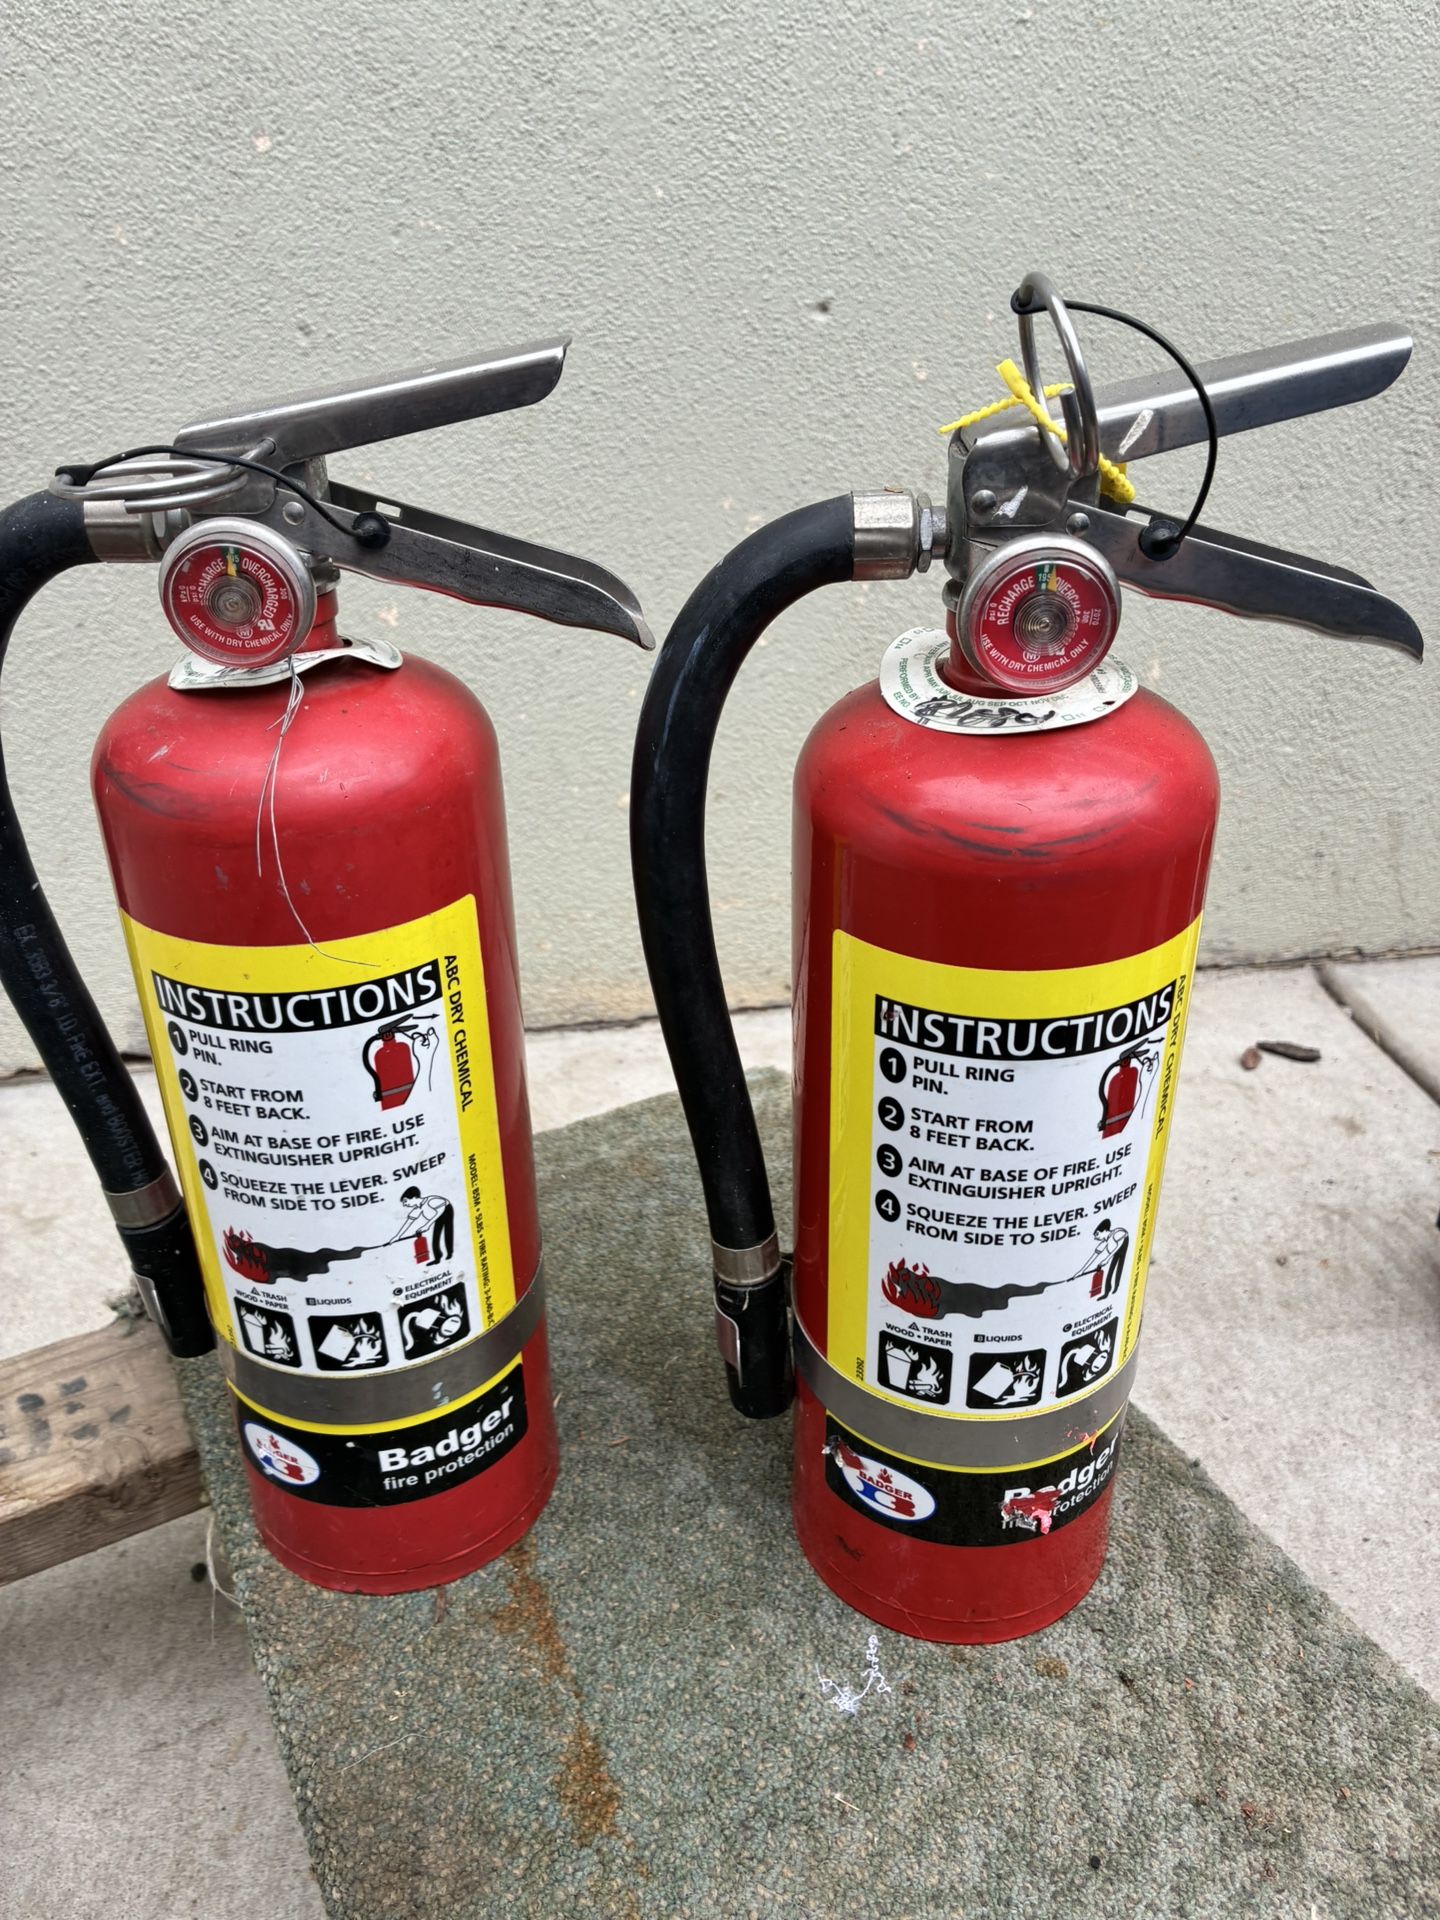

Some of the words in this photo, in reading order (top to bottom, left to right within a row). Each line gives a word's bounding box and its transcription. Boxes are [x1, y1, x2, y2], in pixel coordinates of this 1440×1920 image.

[241, 557, 280, 620] OVERCHARGED
[996, 575, 1036, 626] RECHARGE
[189, 614, 206, 631] USE
[204, 626, 225, 643] WITH
[226, 637, 244, 648] DRY
[244, 630, 283, 648] CHEMICAL
[280, 612, 295, 633] ONLY
[981, 633, 991, 651] USE
[989, 647, 1009, 666] WITH
[1007, 660, 1026, 672] DRY
[1027, 655, 1071, 673] CHEMICAL
[1070, 638, 1090, 658] ONLY
[899, 657, 915, 695] PERFORMED
[908, 692, 921, 702] BY
[926, 677, 940, 688] MAY
[1008, 700, 1029, 708] OCT
[443, 954, 462, 990] ABC
[155, 965, 437, 1030] INSTRUCTIONS
[1175, 973, 1187, 1010] ABC
[448, 992, 467, 1027] DRY
[879, 985, 1173, 1057] INSTRUCTIONS
[189, 1029, 227, 1050] PULL
[230, 1038, 273, 1054] RING
[1169, 1013, 1182, 1047] DRY
[193, 1047, 223, 1067] PIN.
[454, 1028, 476, 1112] CHEMICAL
[912, 1055, 960, 1078] PULL
[965, 1065, 1016, 1083] RING
[199, 1078, 245, 1099] START
[252, 1086, 304, 1104] FROM
[911, 1075, 949, 1096] PIN.
[1153, 1051, 1176, 1141] CHEMICAL
[203, 1095, 213, 1109] 8
[217, 1099, 253, 1118] FEET
[256, 1104, 311, 1121] BACK.
[910, 1106, 970, 1131] START
[975, 1118, 1034, 1134] FROM
[211, 1126, 239, 1145] AIM
[244, 1133, 261, 1148] AT
[268, 1135, 312, 1151] BASE
[318, 1134, 341, 1148] OF
[345, 1125, 388, 1145] FIRE.
[392, 1113, 426, 1135] USE
[909, 1124, 921, 1140] 8
[926, 1128, 970, 1150] FEET
[975, 1135, 1036, 1153] BACK.
[213, 1142, 334, 1167] EXTINGUISHER
[339, 1133, 420, 1164] UPRIGHT.
[908, 1156, 946, 1176] AIM
[950, 1165, 975, 1181] AT
[980, 1168, 1029, 1183] BASE
[1033, 1166, 1058, 1181] OF
[1062, 1158, 1101, 1179] FIRE.
[1105, 1142, 1133, 1167] USE
[220, 1170, 285, 1195] SQUEEZE
[290, 1180, 324, 1196] THE
[329, 1169, 388, 1194] LEVER.
[393, 1151, 448, 1183] SWEEP
[466, 1153, 480, 1189] MODEL:
[907, 1172, 1046, 1200] EXTINGUISHER
[1051, 1164, 1124, 1198] UPRIGHT.
[223, 1186, 267, 1210] FROM
[270, 1194, 308, 1212] SIDE
[313, 1196, 339, 1213] TO
[341, 1188, 385, 1211] SIDE.
[906, 1202, 988, 1229] SQUEEZE
[992, 1216, 1029, 1230] THE
[1033, 1205, 1090, 1229] LEVER.
[1092, 1182, 1138, 1216] SWEEP
[475, 1212, 486, 1234] 5LBS
[905, 1219, 958, 1243] FROM
[963, 1229, 1004, 1246] SIDE
[1009, 1232, 1035, 1246] TO
[1039, 1225, 1082, 1244] SIDE.
[477, 1238, 489, 1258] FIRE
[404, 1269, 453, 1292] ELECTRICAL
[404, 1276, 454, 1301] EQUIPMENT
[234, 1288, 258, 1304] WOOD
[265, 1300, 290, 1311] PAPER
[260, 1291, 288, 1303] TRASH
[316, 1297, 353, 1306] LIQUIDS
[1071, 1311, 1114, 1337] EQUIPMENT
[1073, 1304, 1114, 1329] ELECTRICAL
[885, 1322, 914, 1340] WOOD
[923, 1334, 952, 1347] PAPER
[921, 1327, 953, 1339] TRASH
[985, 1334, 1023, 1343] LIQUIDS
[376, 1394, 515, 1473] Badger
[382, 1473, 420, 1491] fire
[424, 1421, 515, 1486] protection
[858, 1468, 914, 1501] BADGER
